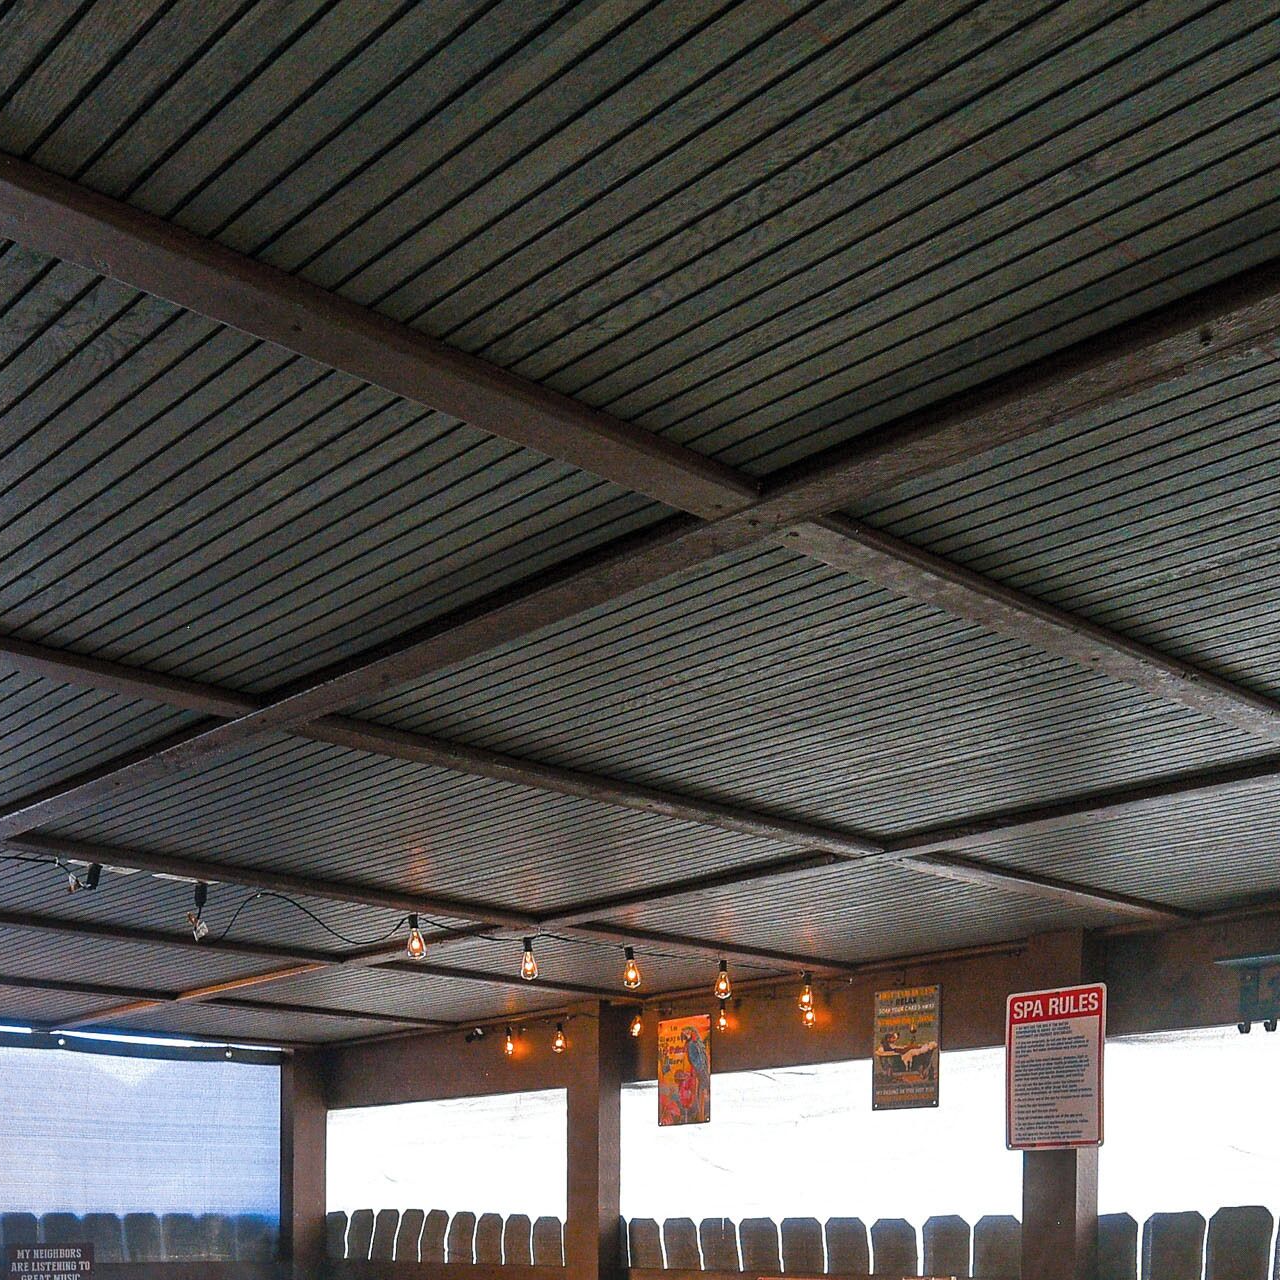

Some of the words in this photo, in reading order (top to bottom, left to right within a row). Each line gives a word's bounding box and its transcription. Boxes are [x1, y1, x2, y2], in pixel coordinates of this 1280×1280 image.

[1013, 1000, 1043, 1020] SPA
[1048, 992, 1099, 1016] RULES
[16, 1249, 30, 1259] MY
[33, 1248, 82, 1259] NEIGHBORS
[11, 1262, 29, 1273] ARE
[32, 1261, 77, 1272] LISTENING
[79, 1261, 90, 1271] TO
